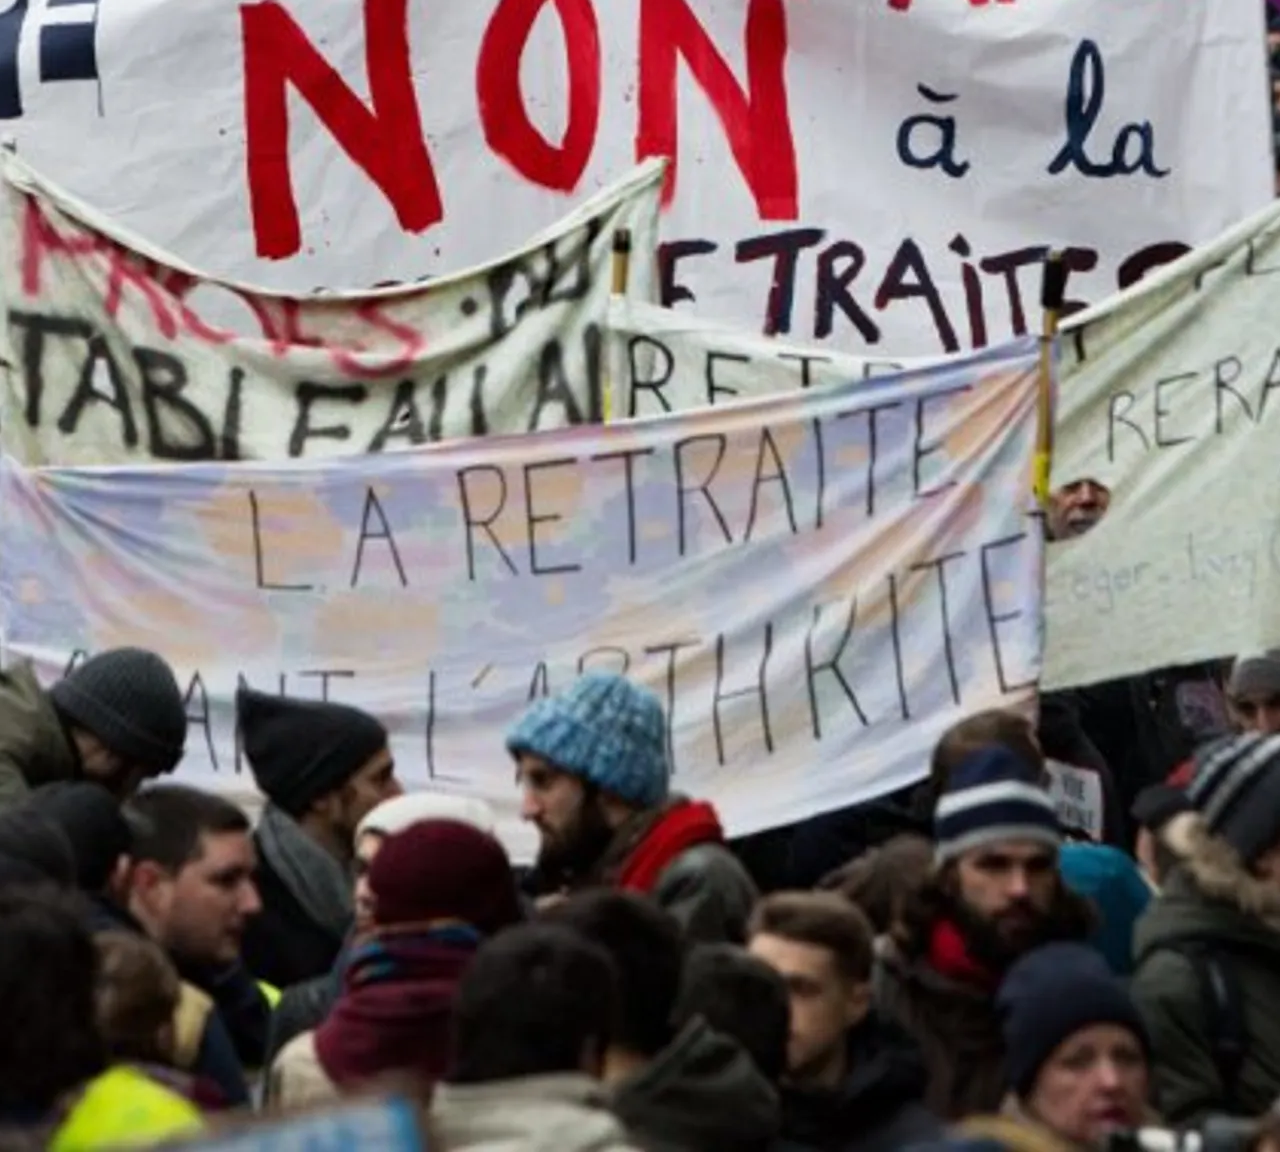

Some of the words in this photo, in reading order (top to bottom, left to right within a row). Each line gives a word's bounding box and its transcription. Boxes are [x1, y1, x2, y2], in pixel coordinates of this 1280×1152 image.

[896, 83, 970, 178] à
[1046, 39, 1171, 178] la
[249, 485, 409, 592] LA
[456, 385, 976, 581] RETRAITE
